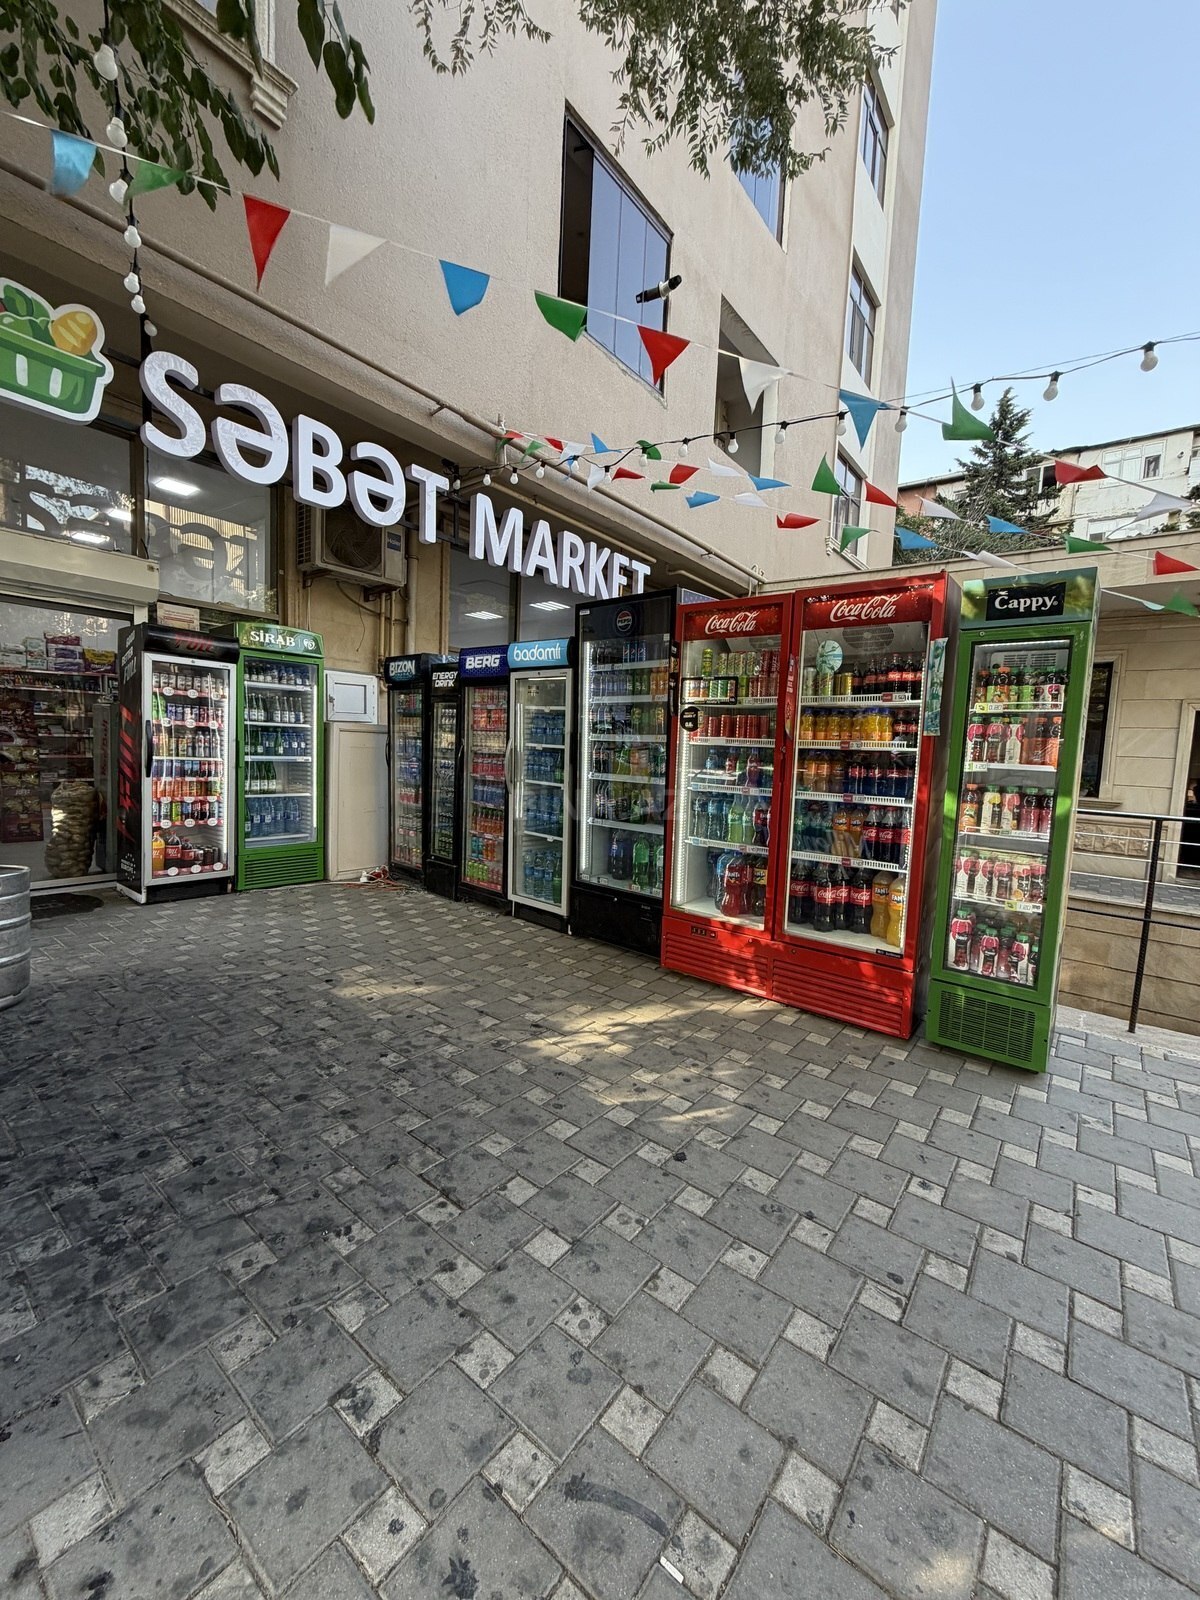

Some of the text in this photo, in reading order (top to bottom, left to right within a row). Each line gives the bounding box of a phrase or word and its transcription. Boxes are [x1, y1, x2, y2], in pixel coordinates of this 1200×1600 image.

[469, 492, 651, 600] MARKET
[389, 659, 416, 677] BIZON
[465, 654, 501, 670] BERG
[432, 671, 458, 681] ENERGY
[434, 679, 455, 688] DRINK
